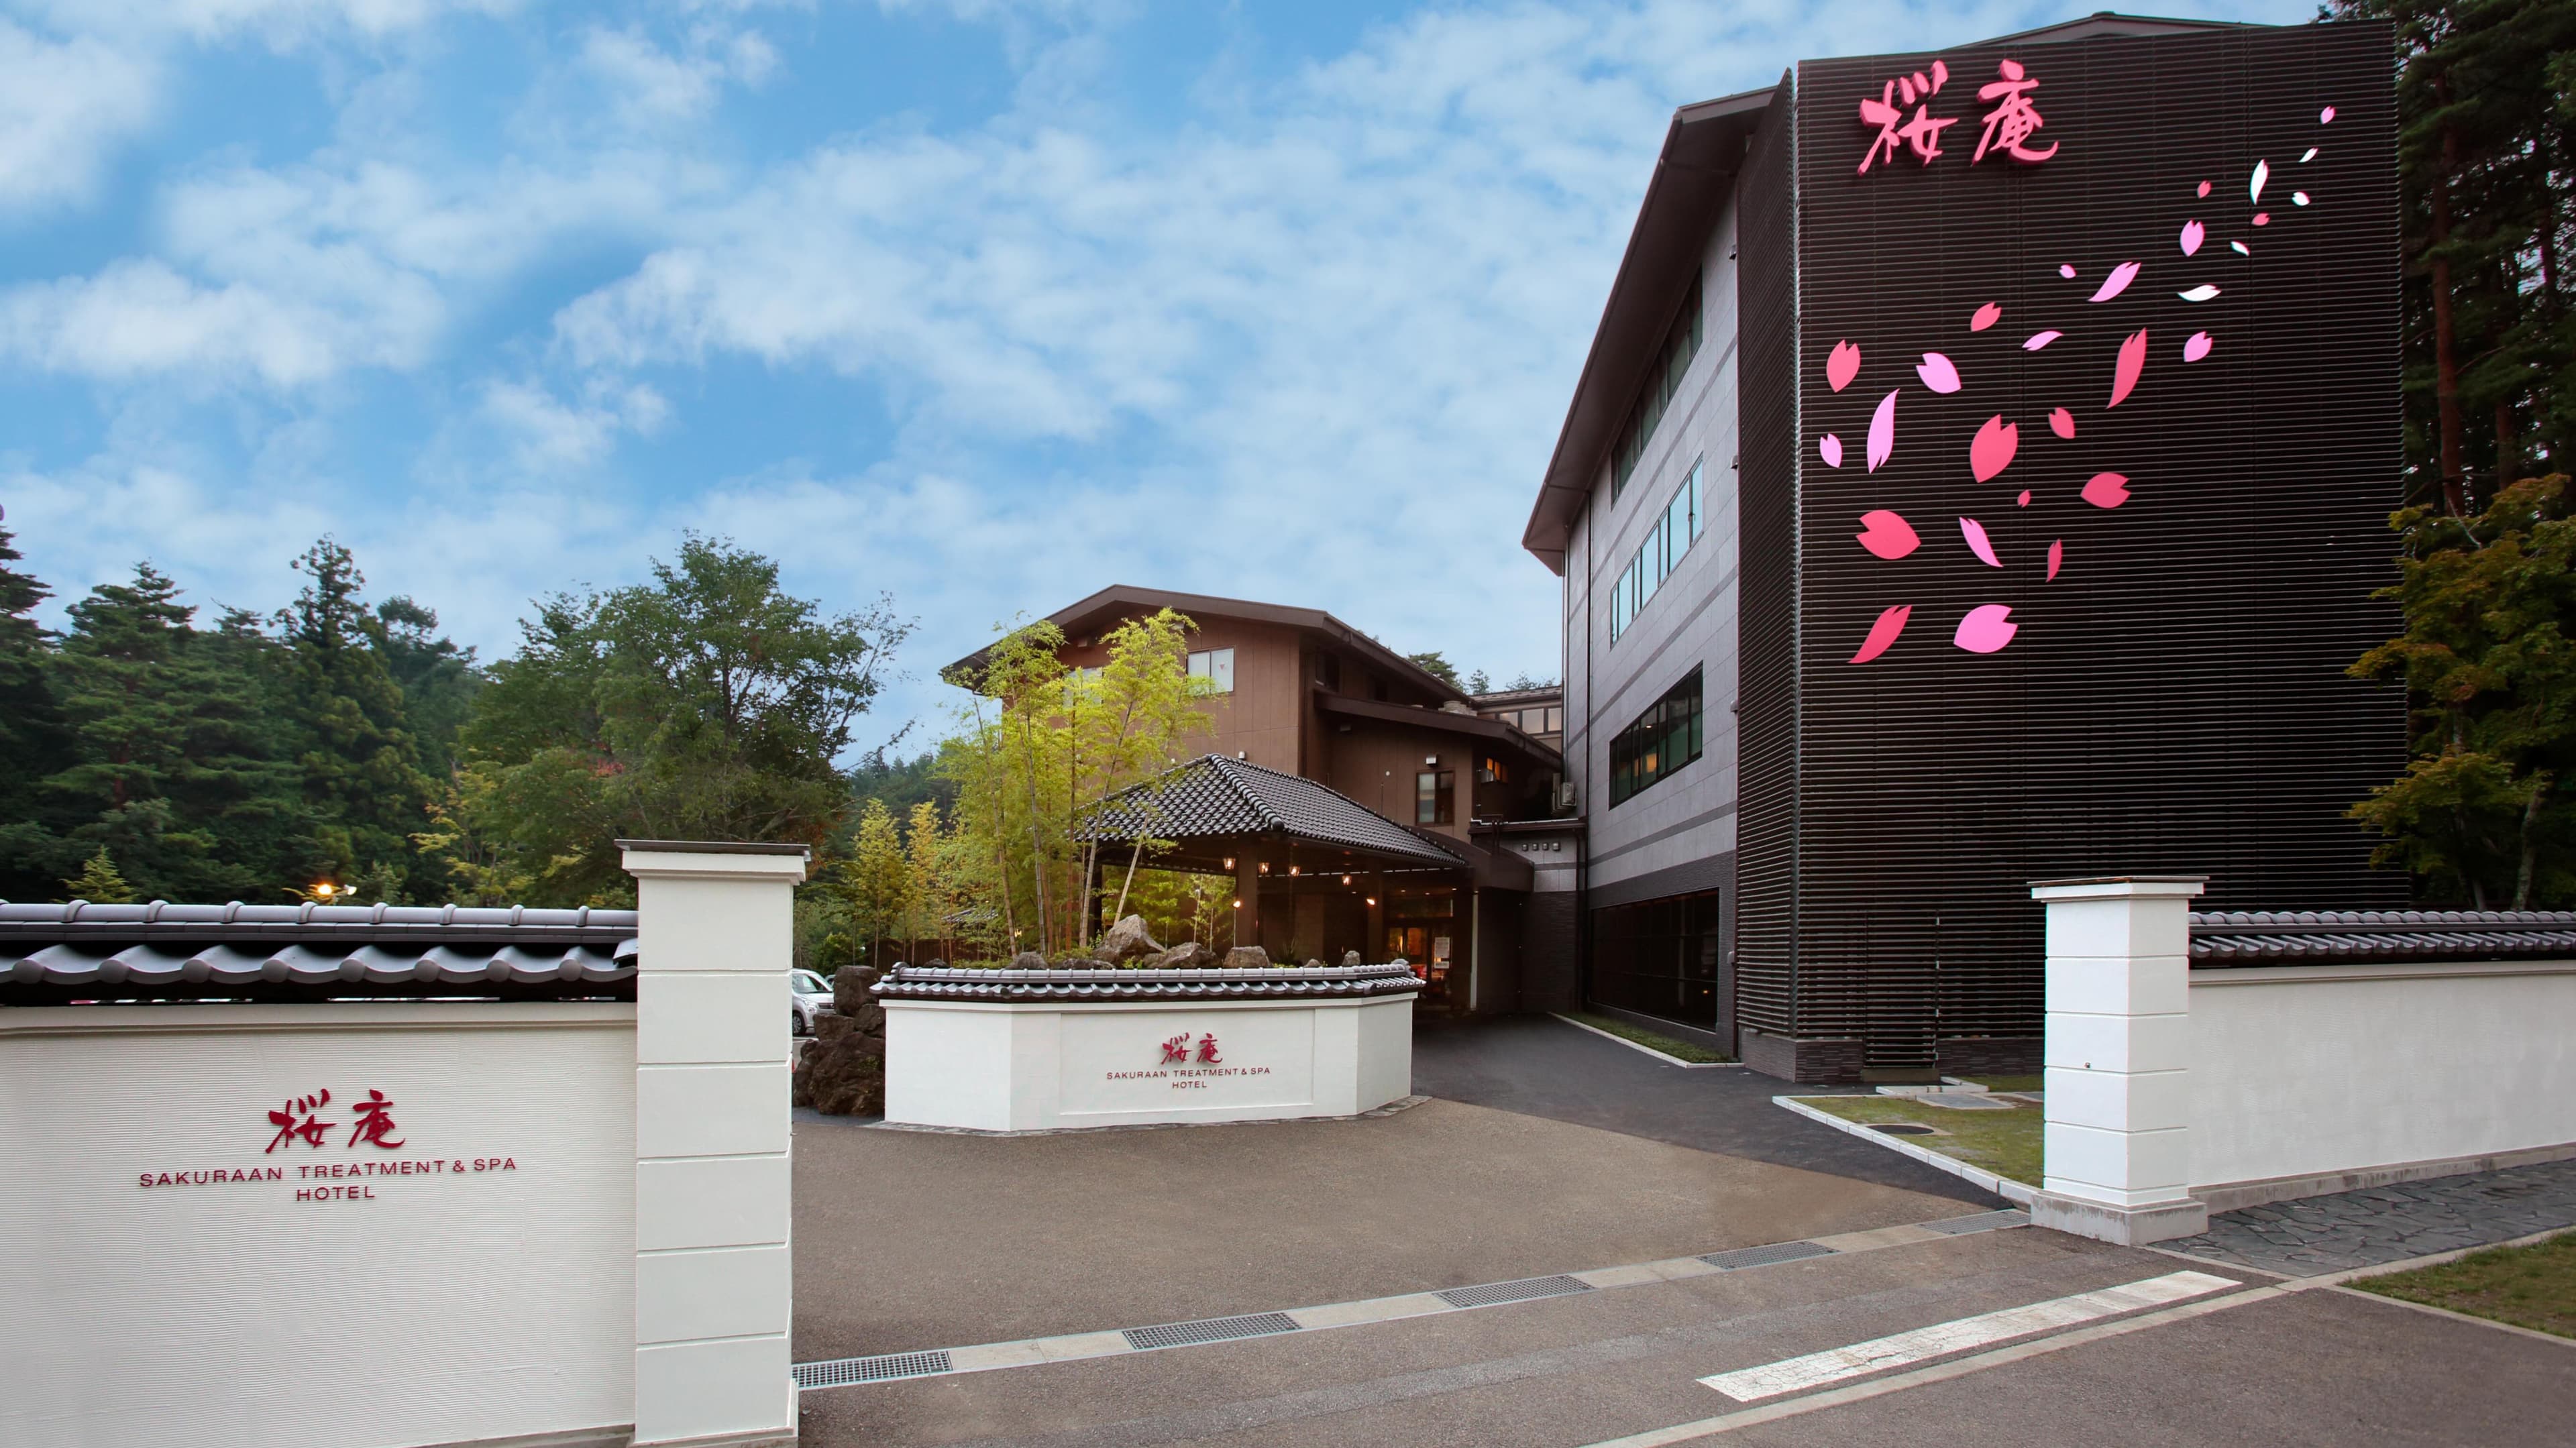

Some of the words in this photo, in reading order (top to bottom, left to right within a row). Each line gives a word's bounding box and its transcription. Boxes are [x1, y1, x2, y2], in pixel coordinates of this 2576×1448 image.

[1106, 1070, 1167, 1080] SAKURAAN
[1173, 1068, 1238, 1077] TREATMENT
[1250, 1067, 1271, 1075] SPA
[1172, 1080, 1208, 1089] HOTEL
[139, 1166, 282, 1188] SAKURAAN
[298, 1160, 445, 1179] TREATMENT
[452, 1160, 466, 1173] &
[473, 1157, 517, 1172] SPA
[296, 1185, 376, 1202] HOTEL
